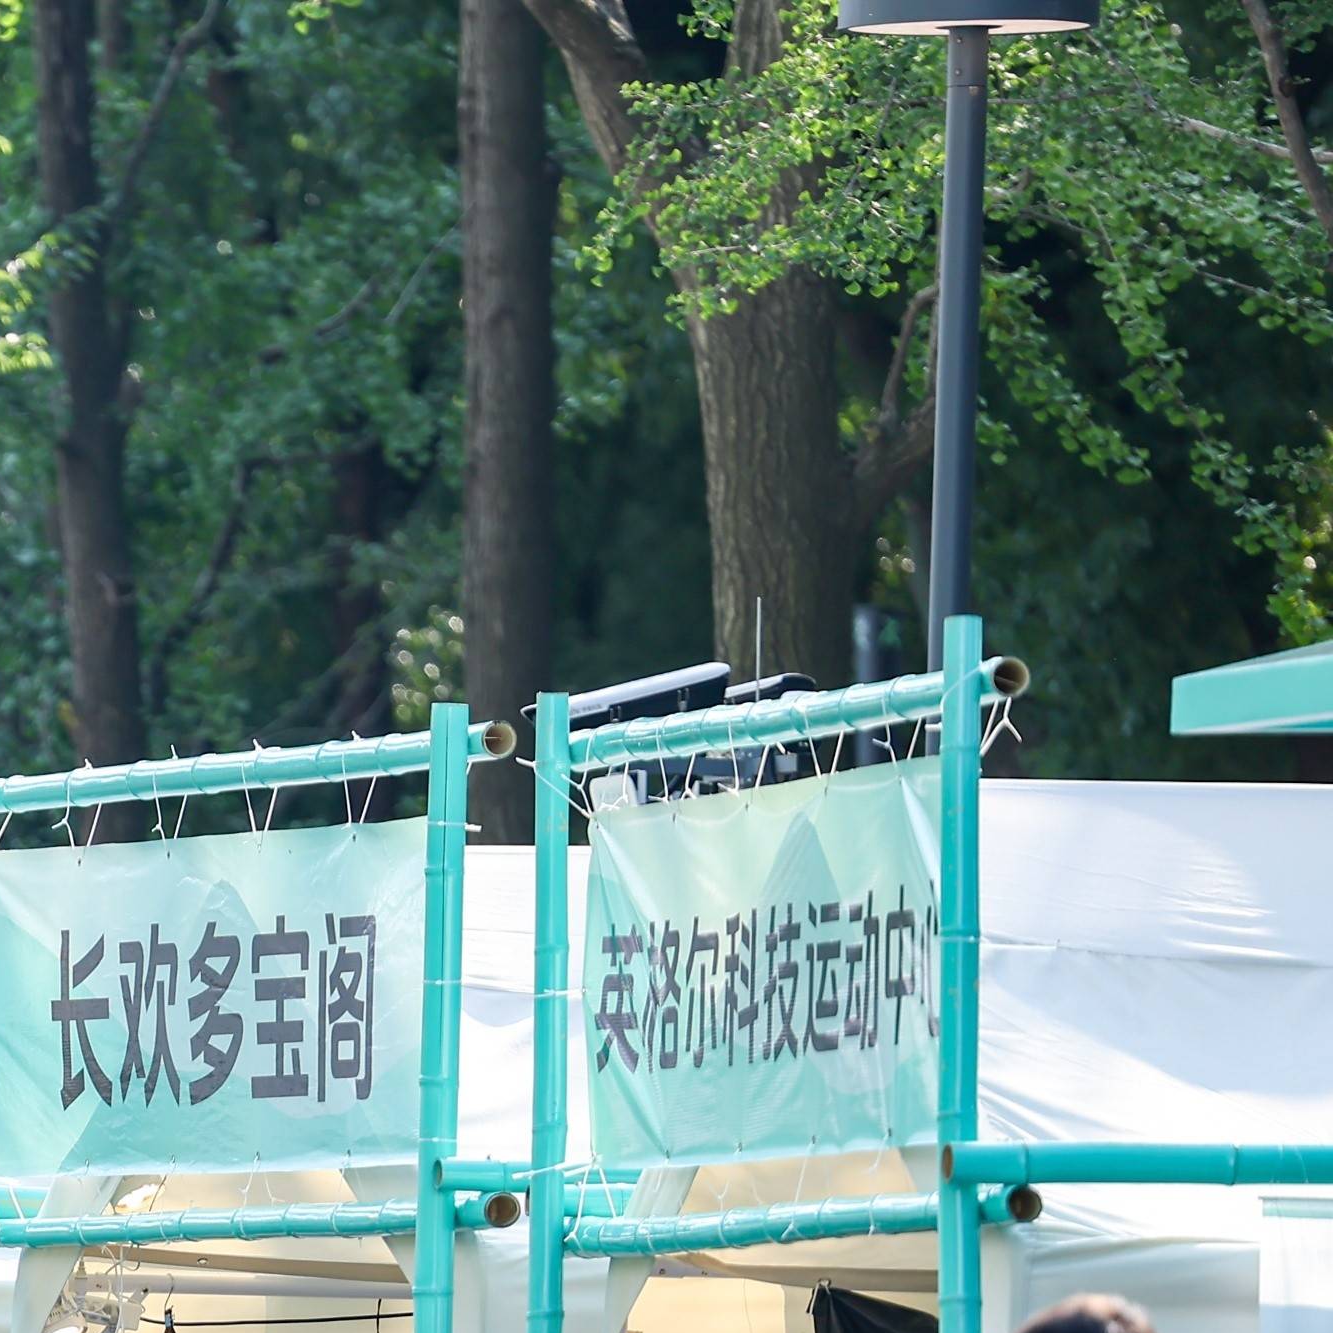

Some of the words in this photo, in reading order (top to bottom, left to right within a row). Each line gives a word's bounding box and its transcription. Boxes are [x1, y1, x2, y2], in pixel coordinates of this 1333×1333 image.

[51, 912, 376, 1111] 长欢多宝阁
